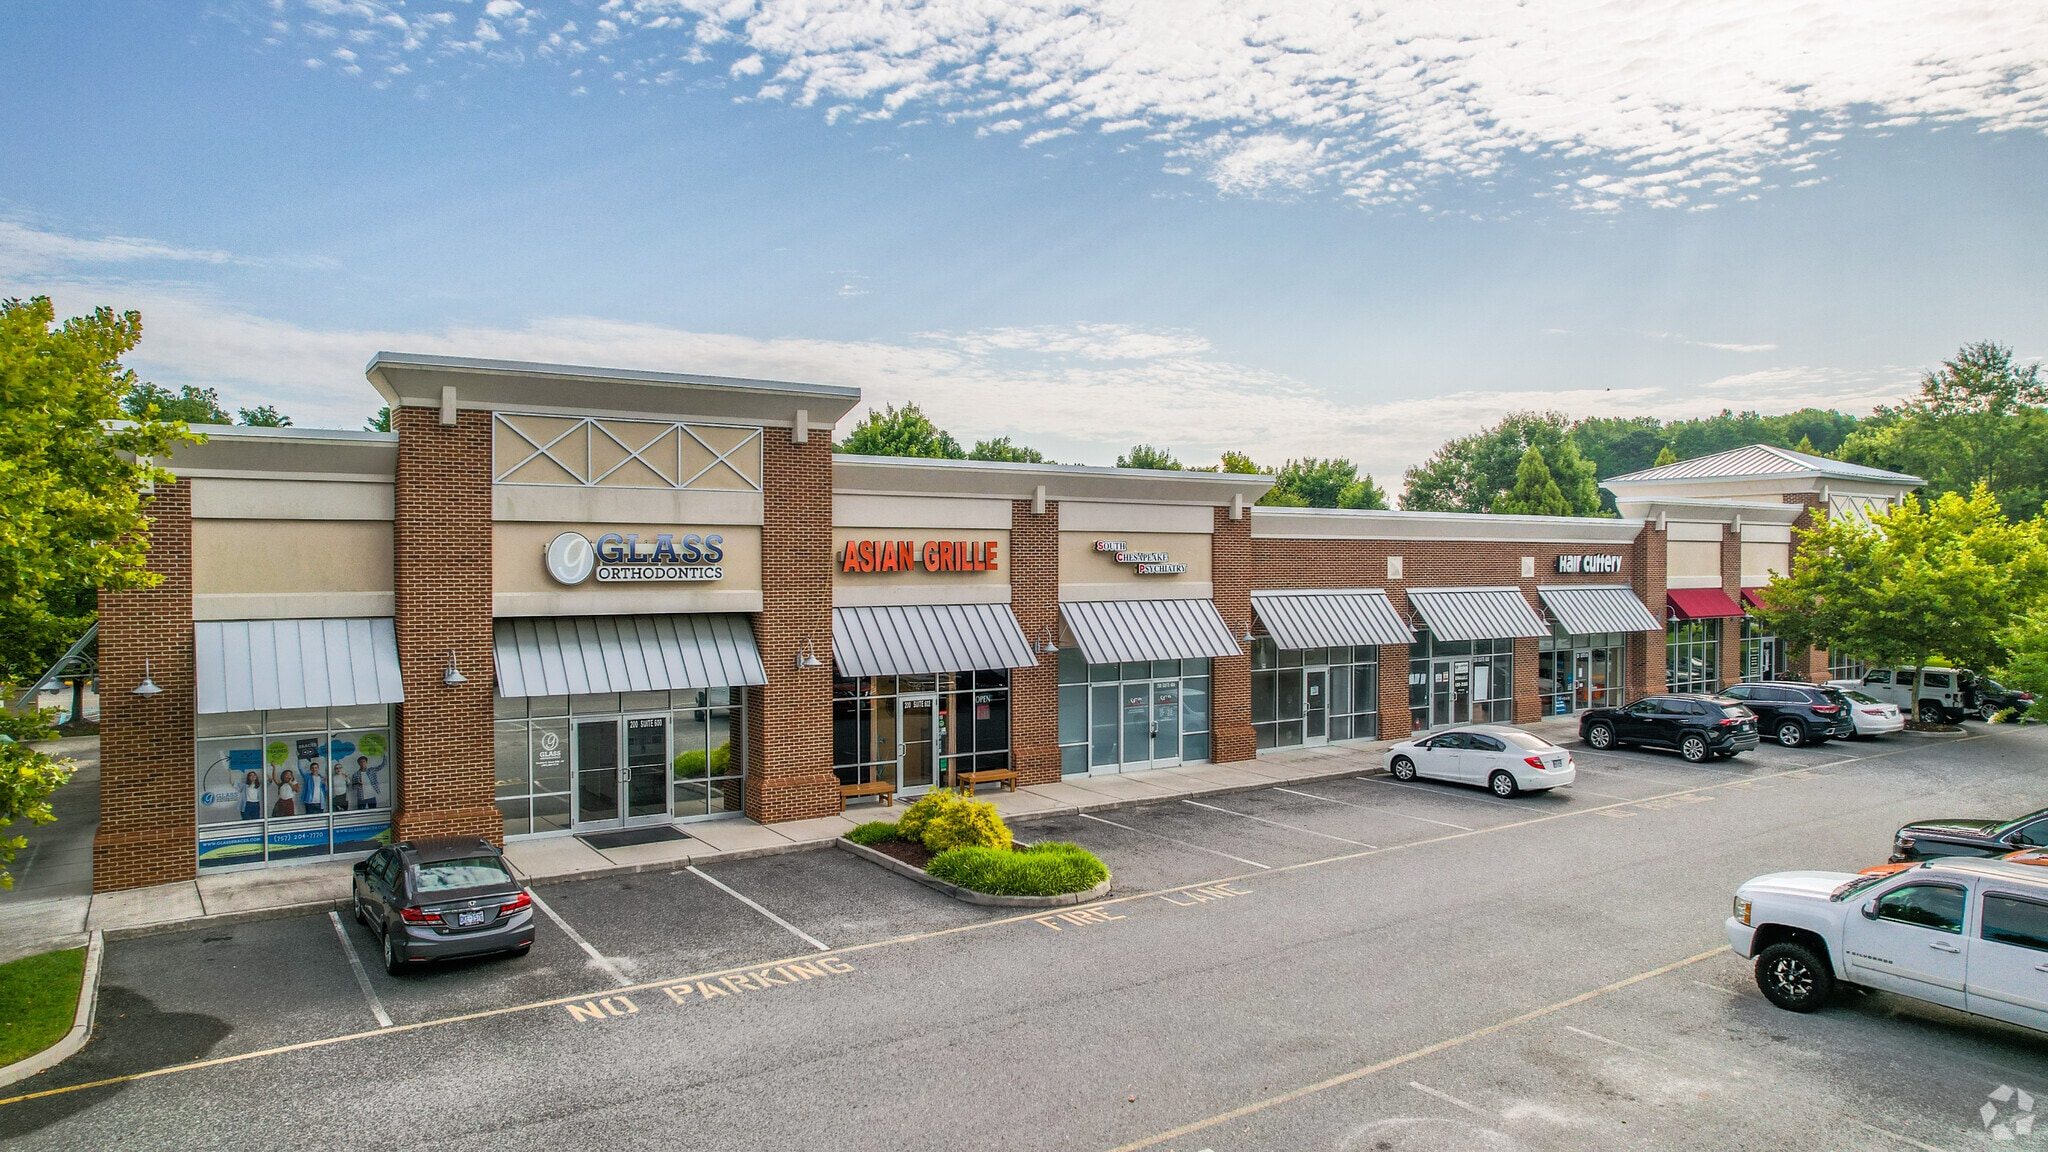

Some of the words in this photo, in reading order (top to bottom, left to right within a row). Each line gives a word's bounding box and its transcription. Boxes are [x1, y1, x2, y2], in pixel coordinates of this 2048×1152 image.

[596, 533, 724, 564] GLASS
[843, 540, 915, 572] ASIAN
[923, 540, 998, 572] GRILLE
[1559, 555, 1581, 572] Hair
[599, 567, 723, 580] ORTHODONTICS
[913, 700, 924, 708] SUITE
[975, 695, 991, 704] OPEN
[629, 720, 638, 729] 200
[640, 719, 654, 728] SUITE
[654, 719, 662, 727] 600
[539, 750, 561, 758] GLASS
[273, 833, 291, 843] (757)
[294, 831, 324, 840] 204-7770
[1159, 883, 1253, 907] LANE
[1035, 906, 1127, 931] FIRE
[564, 996, 640, 1023] NO
[662, 957, 856, 1006] PARKING
